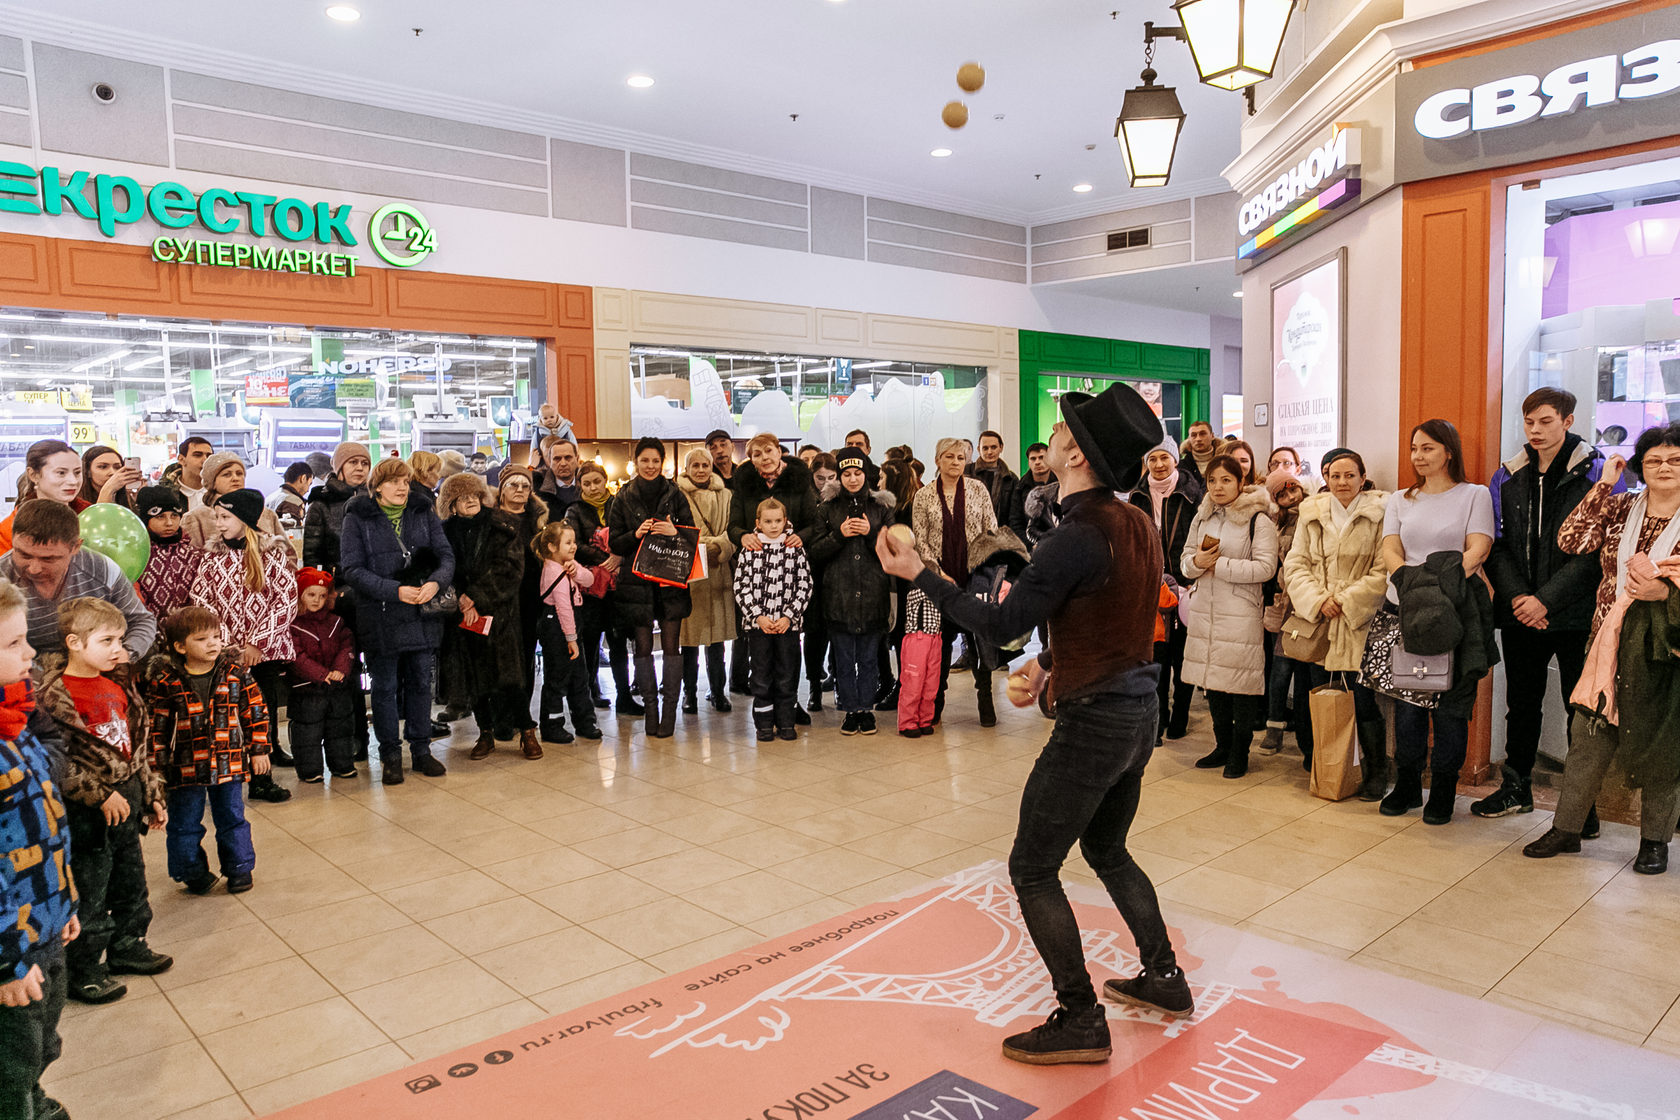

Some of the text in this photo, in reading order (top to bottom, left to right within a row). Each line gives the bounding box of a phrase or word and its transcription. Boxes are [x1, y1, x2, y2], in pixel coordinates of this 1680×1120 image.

[1238, 126, 1346, 236] СВЯЗНОЙ
[408, 226, 438, 252] 24
[153, 236, 359, 277] СУПЕРМАРКЕТ
[23, 392, 49, 400] СУПЕР
[1278, 397, 1334, 418] СЛАДКАЯ ЦЕНА
[73, 427, 88, 440] 99
[289, 441, 316, 450] ТАБАК
[684, 909, 900, 992] подробнее на сайте
[519, 997, 663, 1052] frbulvar.ru
[834, 1063, 890, 1090] ЗА
